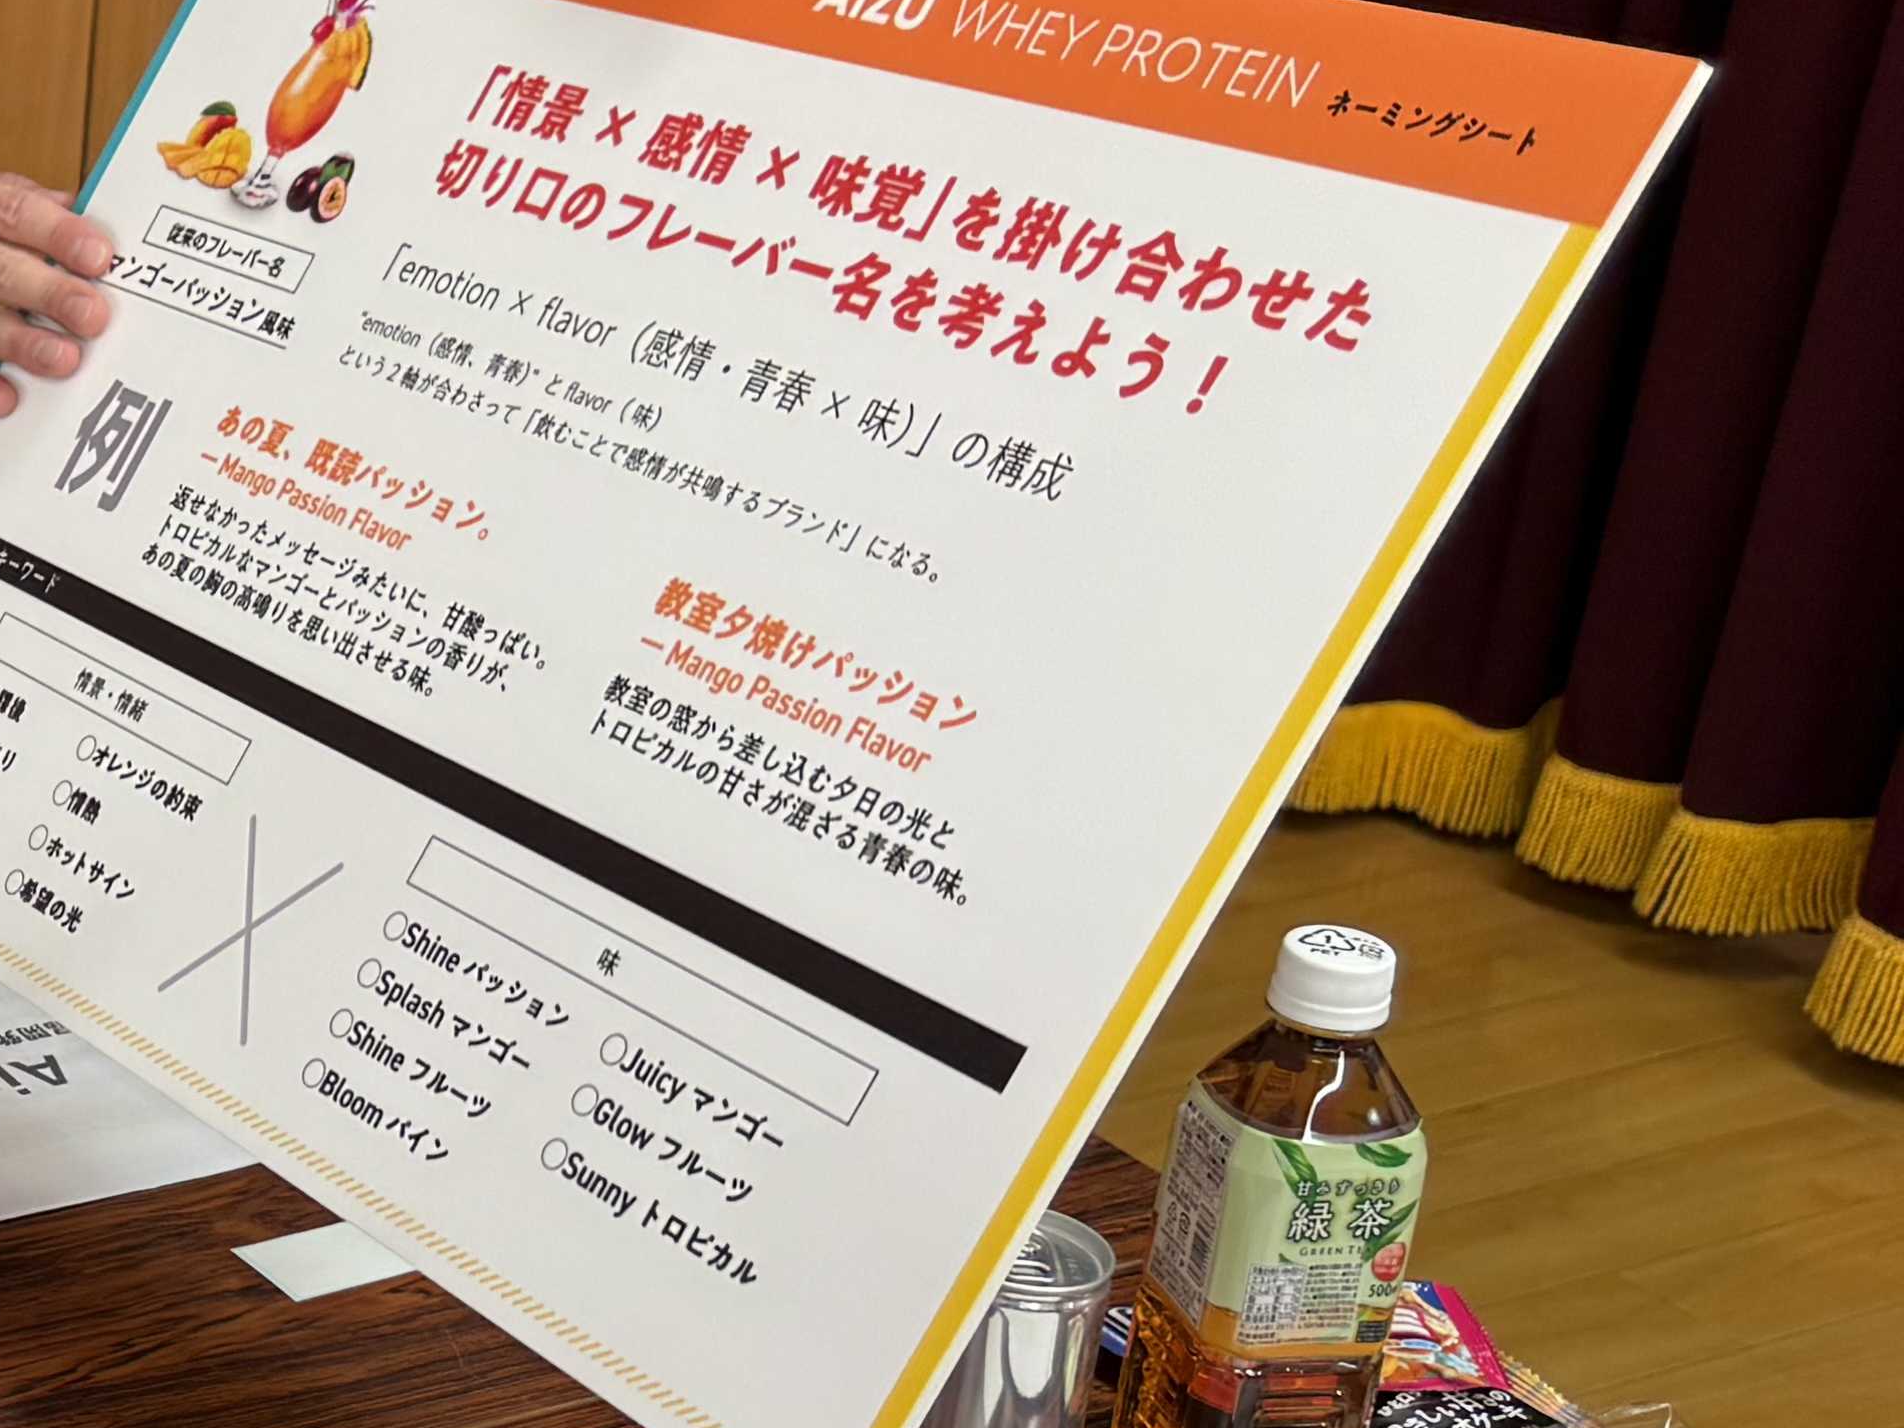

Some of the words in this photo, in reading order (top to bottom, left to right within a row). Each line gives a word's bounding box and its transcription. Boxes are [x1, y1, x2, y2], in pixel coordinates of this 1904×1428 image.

[467, 64, 589, 143] 「情景
[638, 111, 752, 186] 感情
[1092, 21, 1321, 108] PROTEIN
[1327, 89, 1537, 156] ネーミングシート
[108, 253, 296, 340] マンゴーパッション風味
[166, 223, 285, 279] 従来のフレーバー名
[435, 139, 1228, 414] 切り口のフレーバー名を考えよう！
[537, 295, 617, 348] flavor
[54, 379, 173, 512] 例
[217, 405, 489, 541] あの夏、既読パッション。
[277, 477, 347, 525] Passion
[350, 507, 413, 551] Flavor
[141, 543, 434, 697] あの夏の胸の高鳴りを思い出させる味。
[158, 513, 508, 692] トロピカルなマンゴーとパッションの香りが、
[654, 577, 978, 731] 教室夕焼けパッション
[602, 674, 956, 851] 教室の窓から差し込む夕日の光と
[746, 674, 843, 739] Passion
[845, 716, 933, 773] Flavor
[91, 744, 204, 821] オレンジの約束
[589, 708, 967, 907] トロピカルの甘さが混ざる青春の味。
[18, 876, 84, 933] 希望の光
[44, 834, 136, 900] ホットサイン
[402, 923, 461, 973] Shine
[463, 961, 571, 1029] パッション
[596, 948, 621, 977] 味
[346, 1020, 406, 1074] Shine
[408, 1058, 492, 1118] フルーツ
[374, 969, 447, 1031] Splash
[450, 1014, 531, 1071] マンゴー
[318, 1072, 385, 1128] Bloom
[386, 1115, 450, 1164] パイン
[592, 1099, 653, 1151] Glow
[662, 1137, 754, 1203] フルーツ
[620, 1049, 688, 1104] Juicy
[692, 1087, 785, 1150] マンゴー
[560, 1152, 637, 1218] Sunny
[641, 1200, 758, 1287] トロピカル
